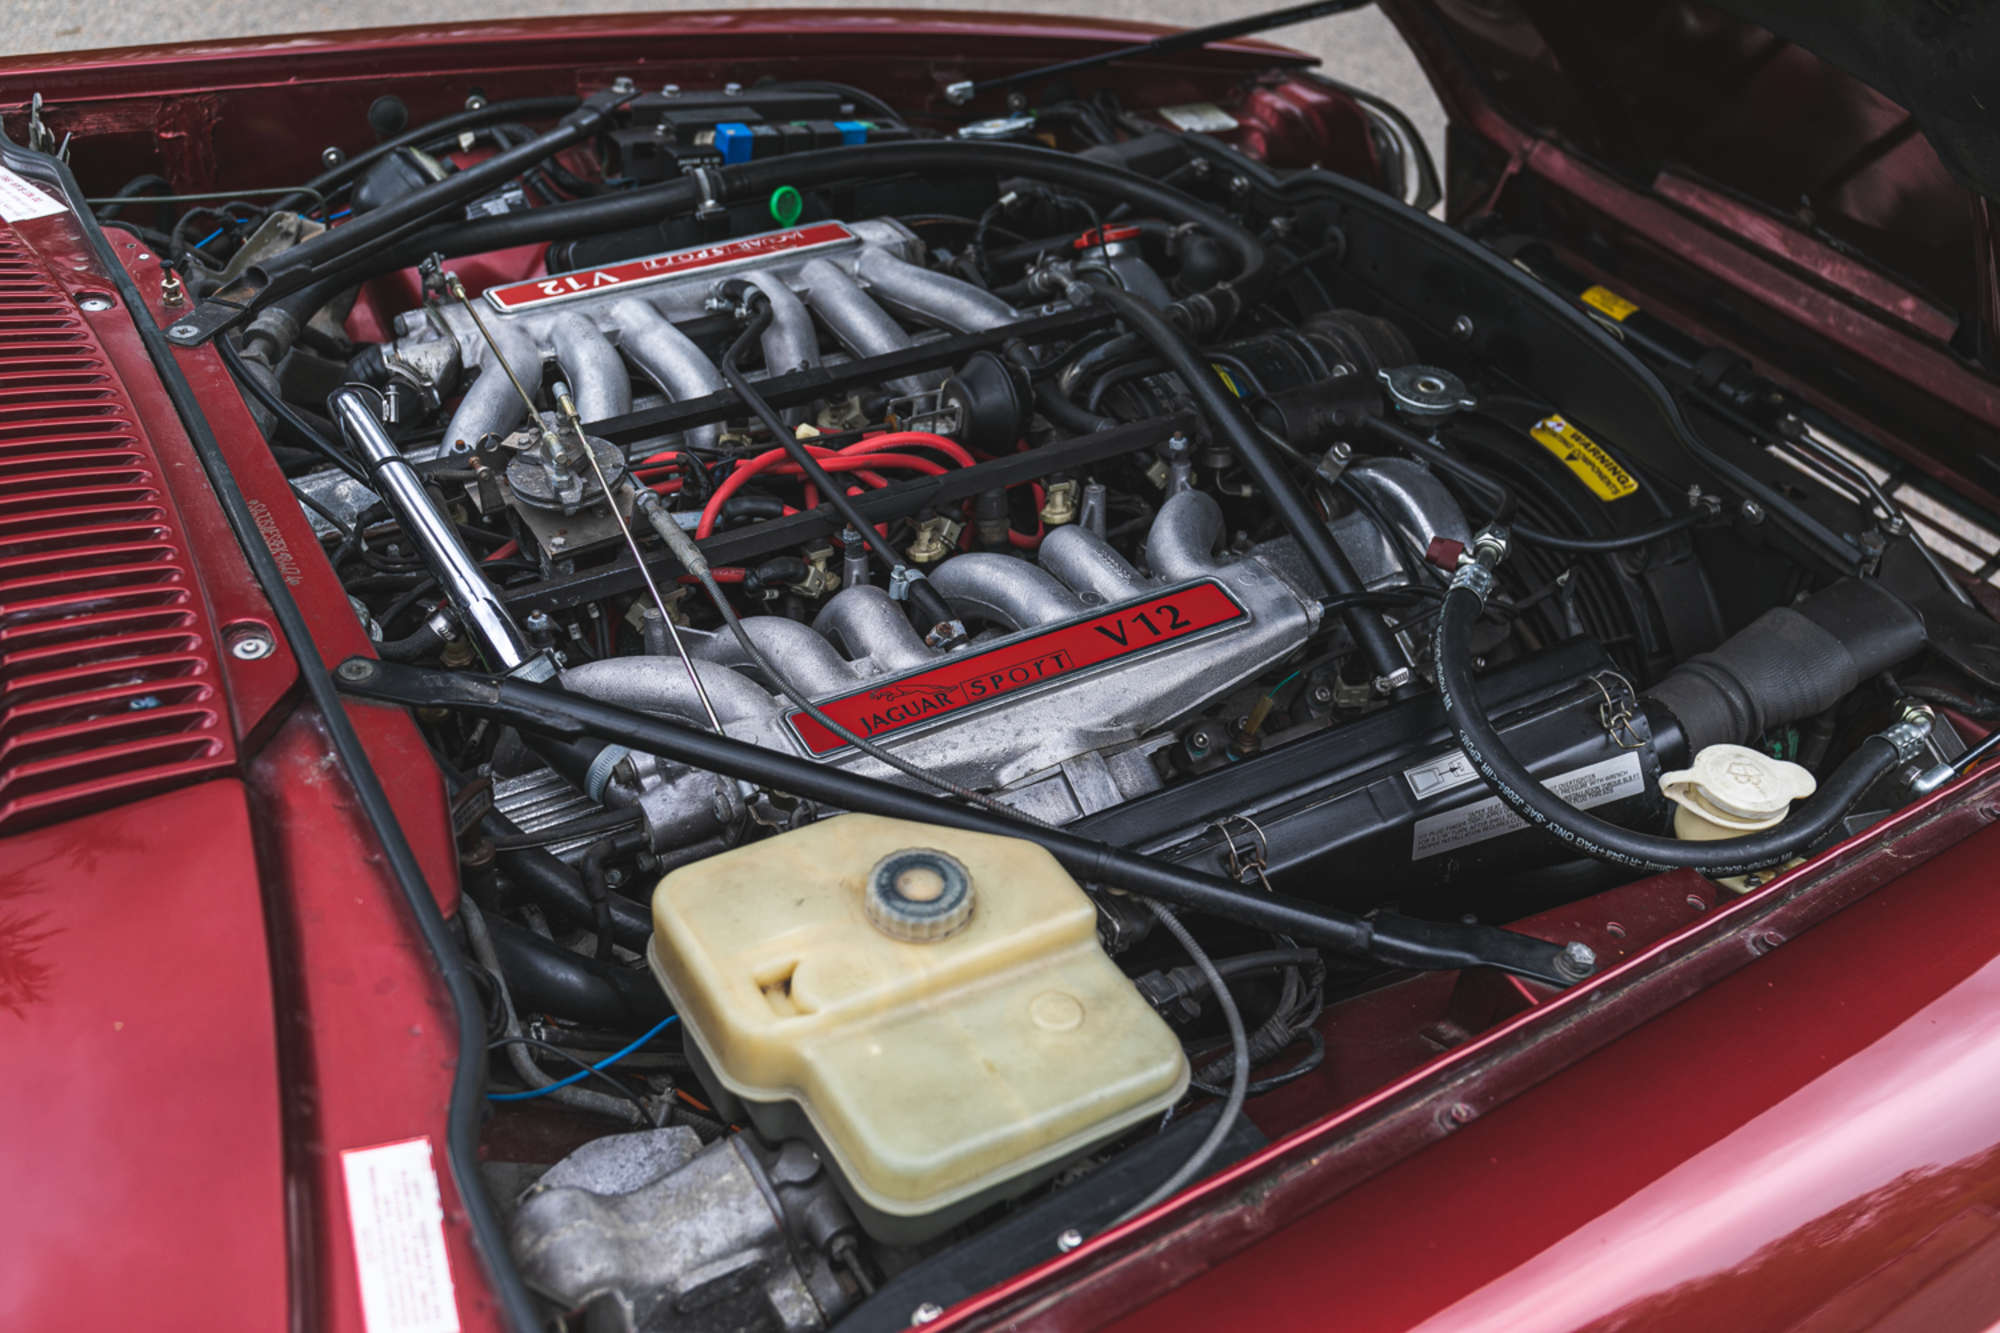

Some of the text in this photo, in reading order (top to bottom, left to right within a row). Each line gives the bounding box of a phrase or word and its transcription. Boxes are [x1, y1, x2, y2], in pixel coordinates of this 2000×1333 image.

[537, 271, 620, 297] V12
[1570, 432, 1635, 490] WARNING!
[859, 604, 1191, 736] JAGUAR SPORT V12
[1546, 821, 1575, 841] ONLY
